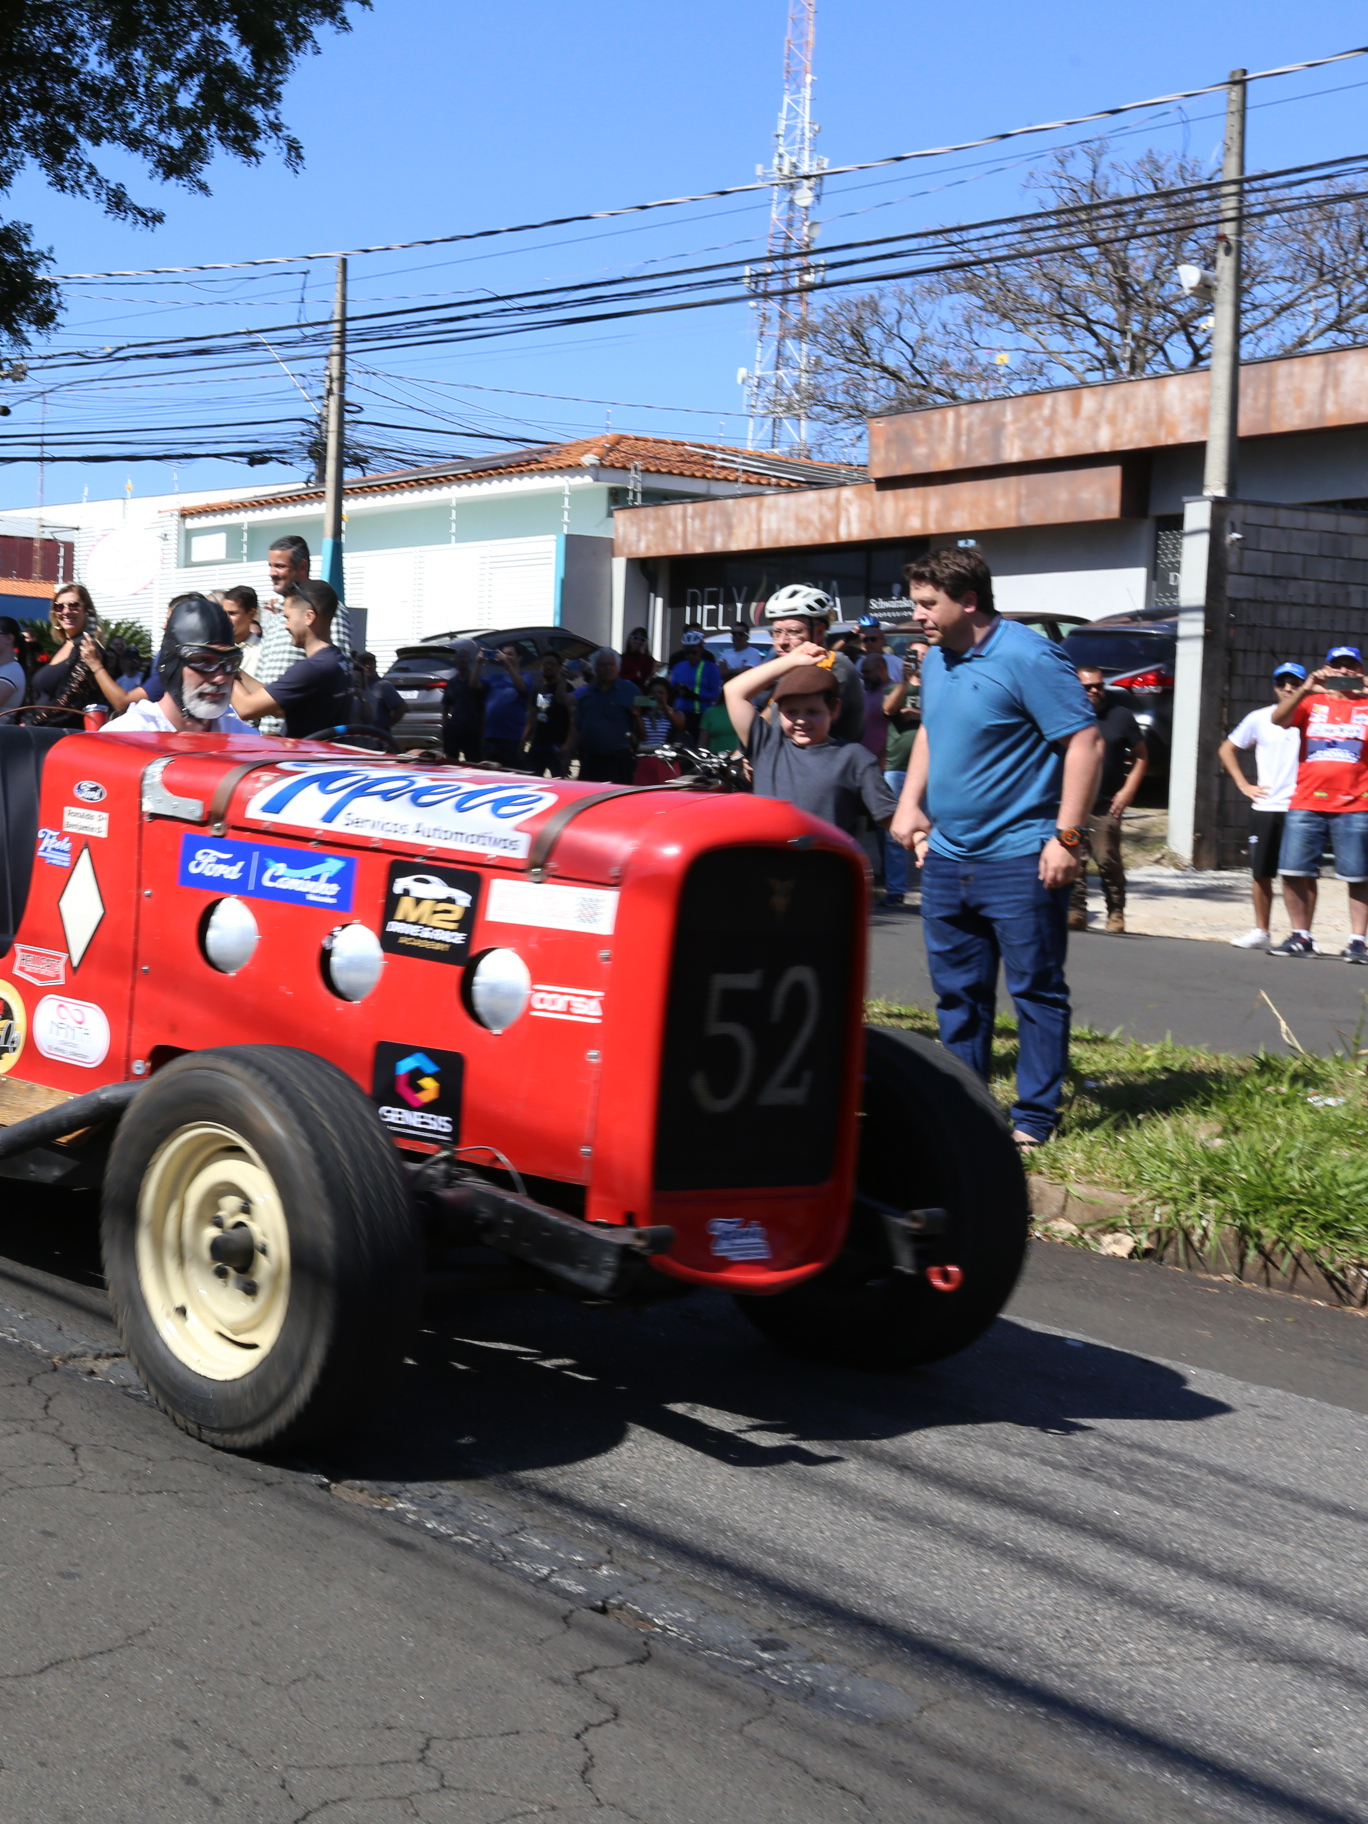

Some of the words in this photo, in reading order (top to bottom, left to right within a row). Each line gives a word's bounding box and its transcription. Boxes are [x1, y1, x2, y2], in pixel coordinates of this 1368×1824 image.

[76, 782, 102, 801] Ford
[343, 813, 410, 835] Serviços
[411, 821, 521, 851] Automotivas
[188, 849, 245, 880] Ford
[394, 896, 465, 930] M2
[689, 965, 821, 1113] 52
[378, 1106, 453, 1132] GENESIS
